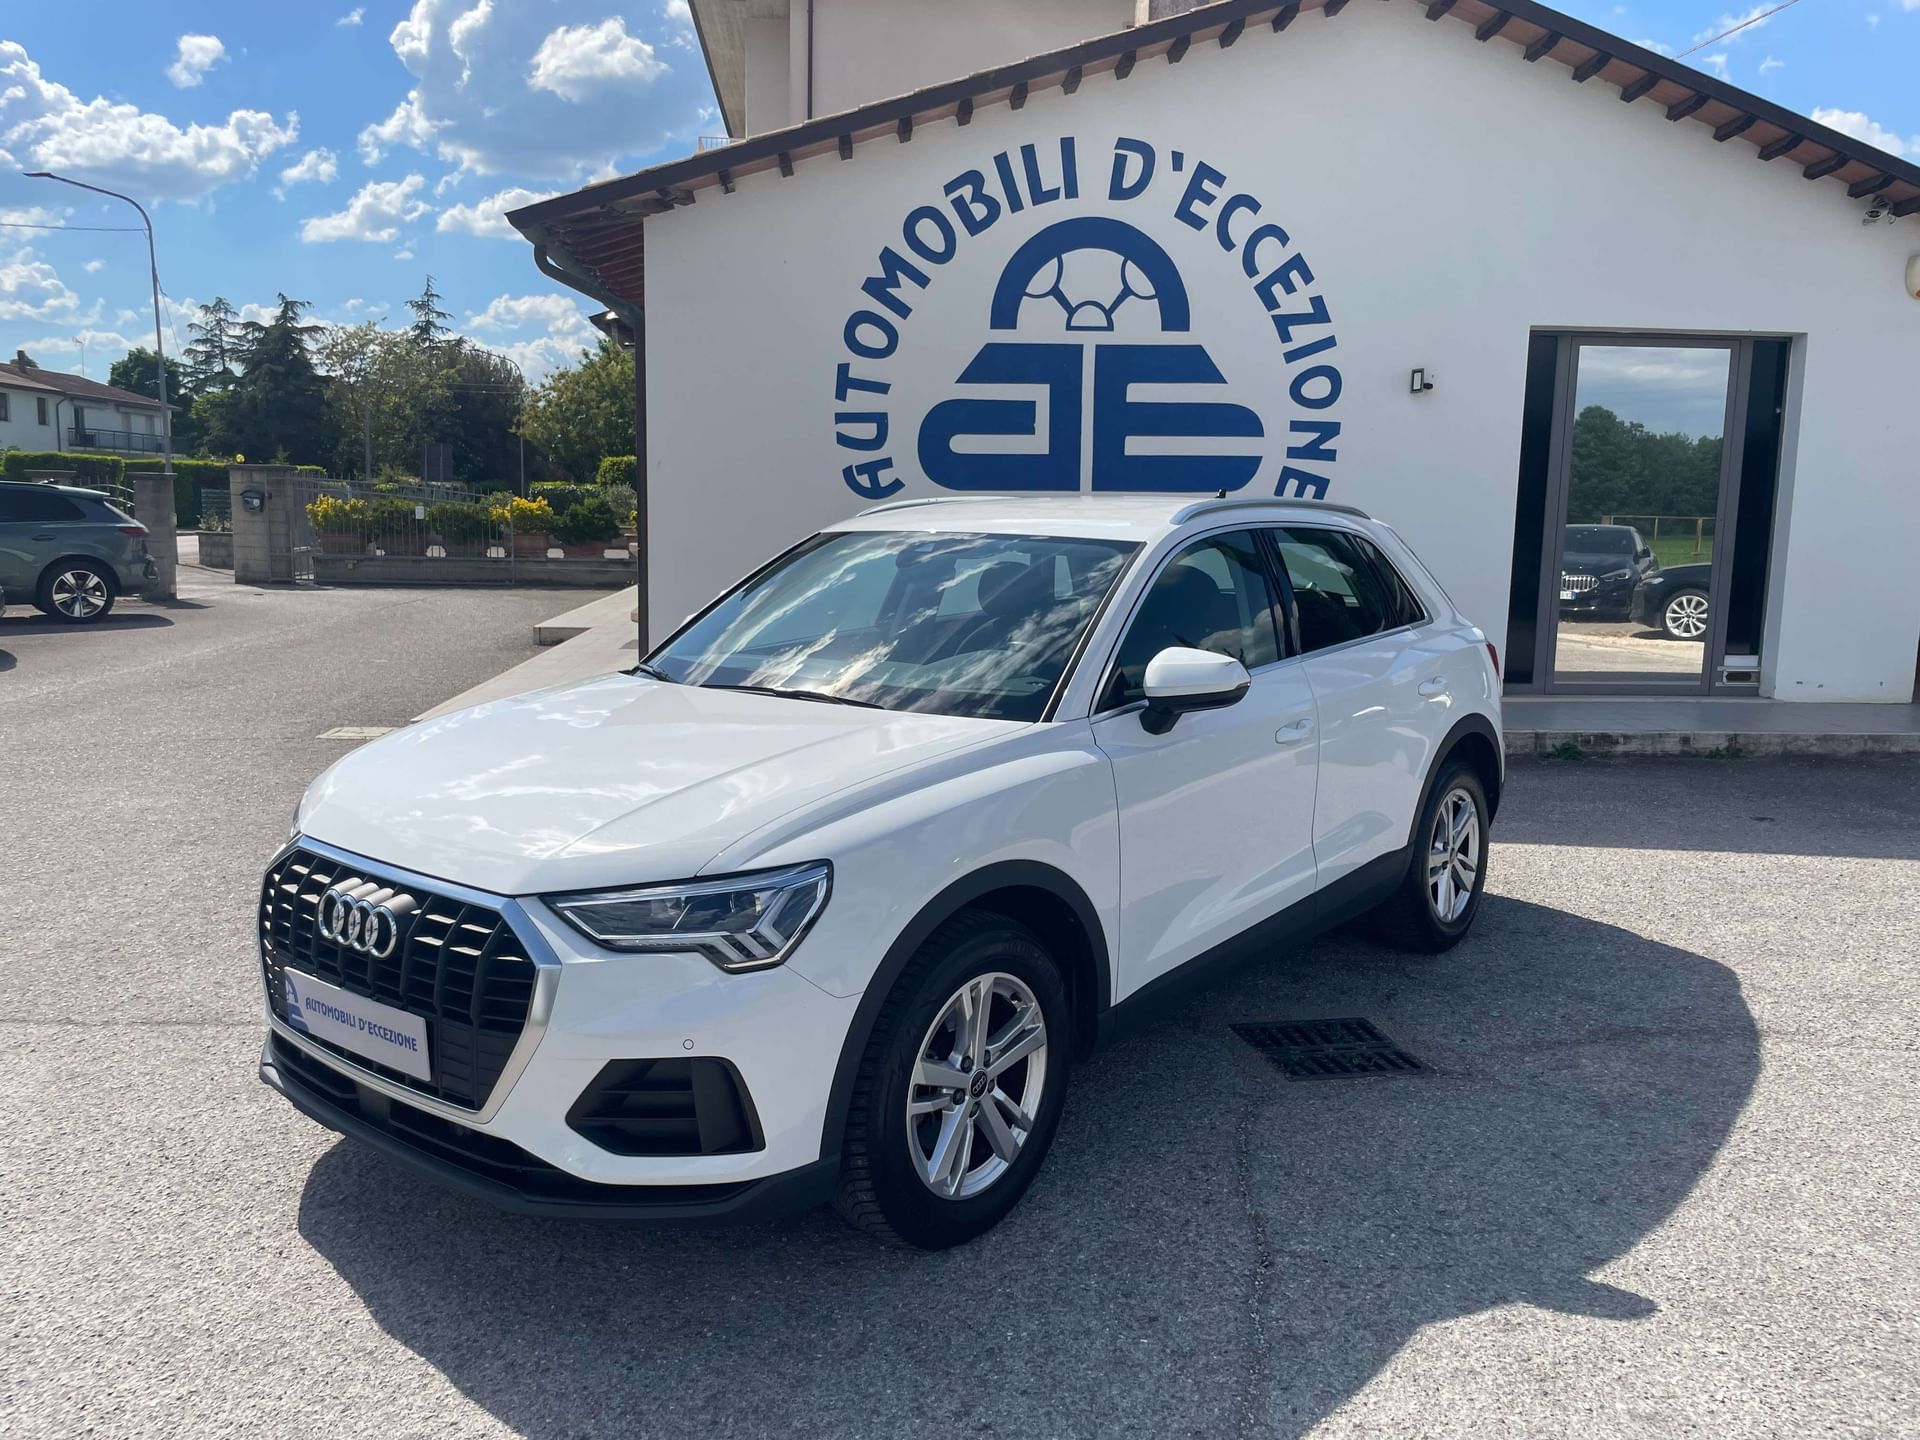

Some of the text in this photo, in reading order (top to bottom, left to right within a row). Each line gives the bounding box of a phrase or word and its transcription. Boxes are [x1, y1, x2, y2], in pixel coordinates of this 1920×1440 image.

[834, 136, 1343, 501] AUTOMOBILI D'ECCEZIONE
[306, 997, 418, 1052] AUTOMOBILI D'ECCEZIONE
